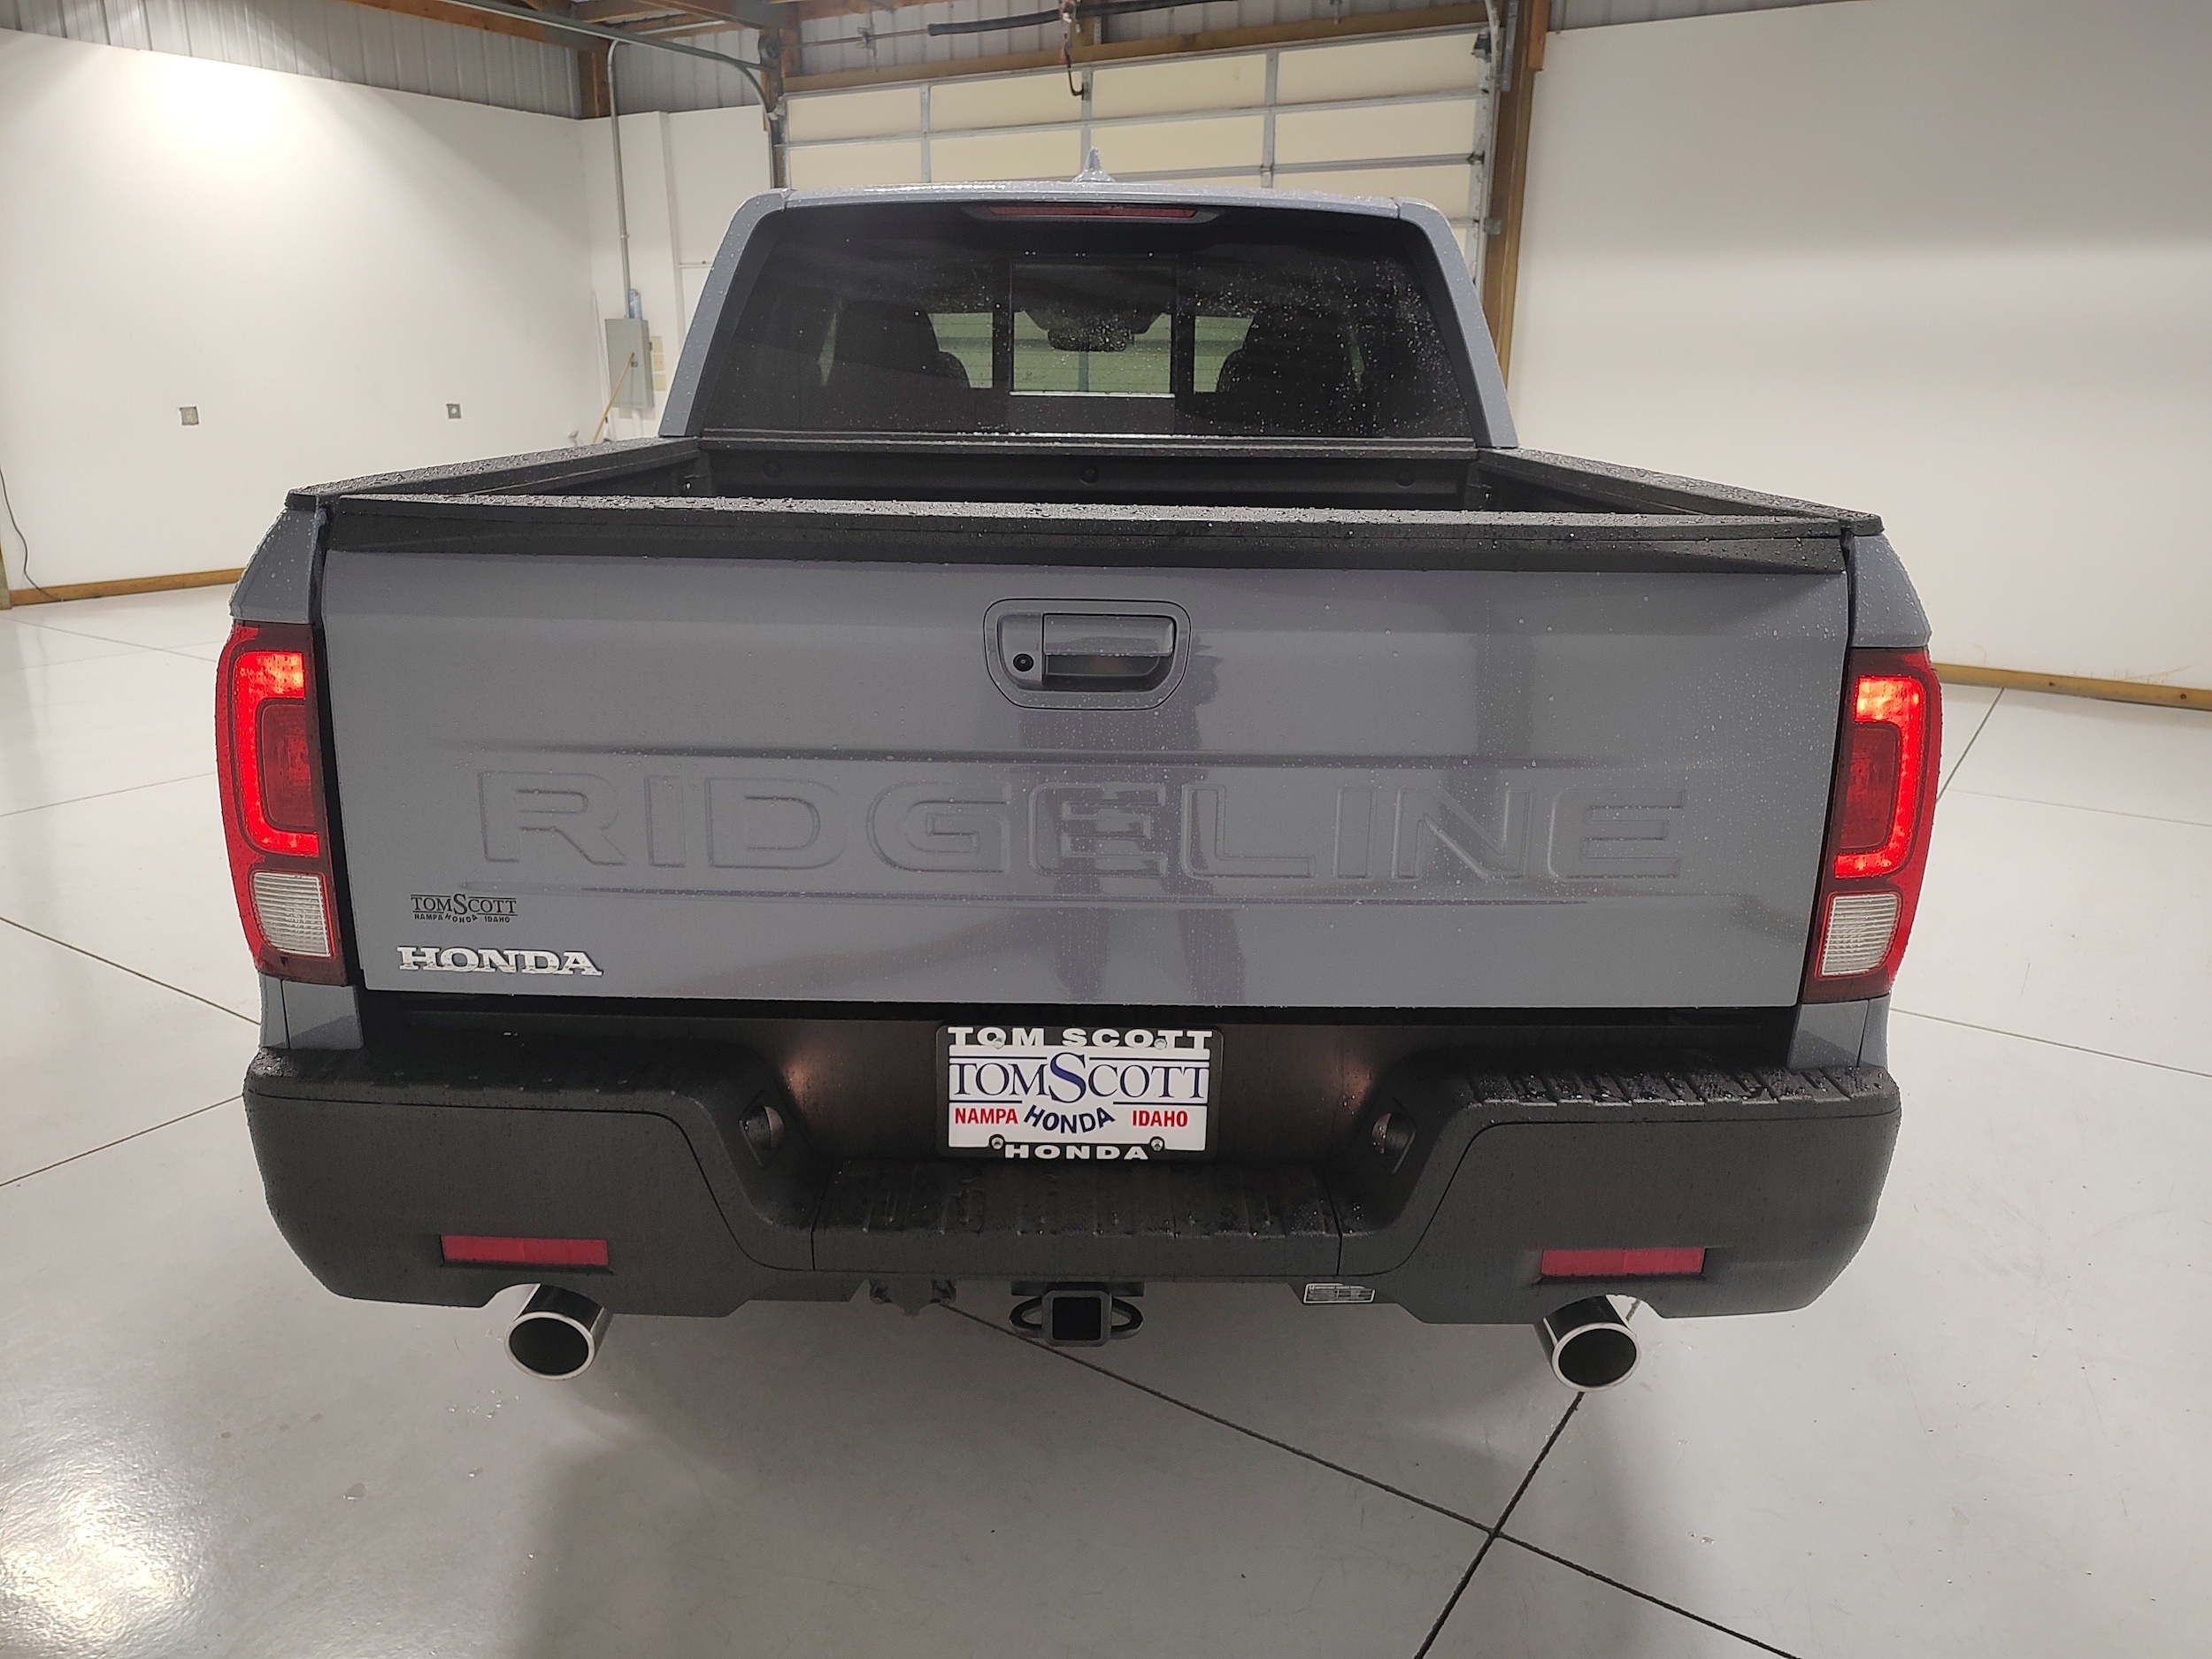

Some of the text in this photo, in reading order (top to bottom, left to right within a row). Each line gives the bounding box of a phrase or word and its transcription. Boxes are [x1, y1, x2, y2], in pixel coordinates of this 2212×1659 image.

[478, 768, 1686, 881] RIDGELINE
[444, 912, 479, 924] HONDA
[397, 946, 603, 977] HONDA
[947, 1026, 1213, 1050] TOM SCOTT
[954, 1104, 1188, 1134] NAMPA HONDA IDAHO
[1004, 1144, 1149, 1161] HONDA
